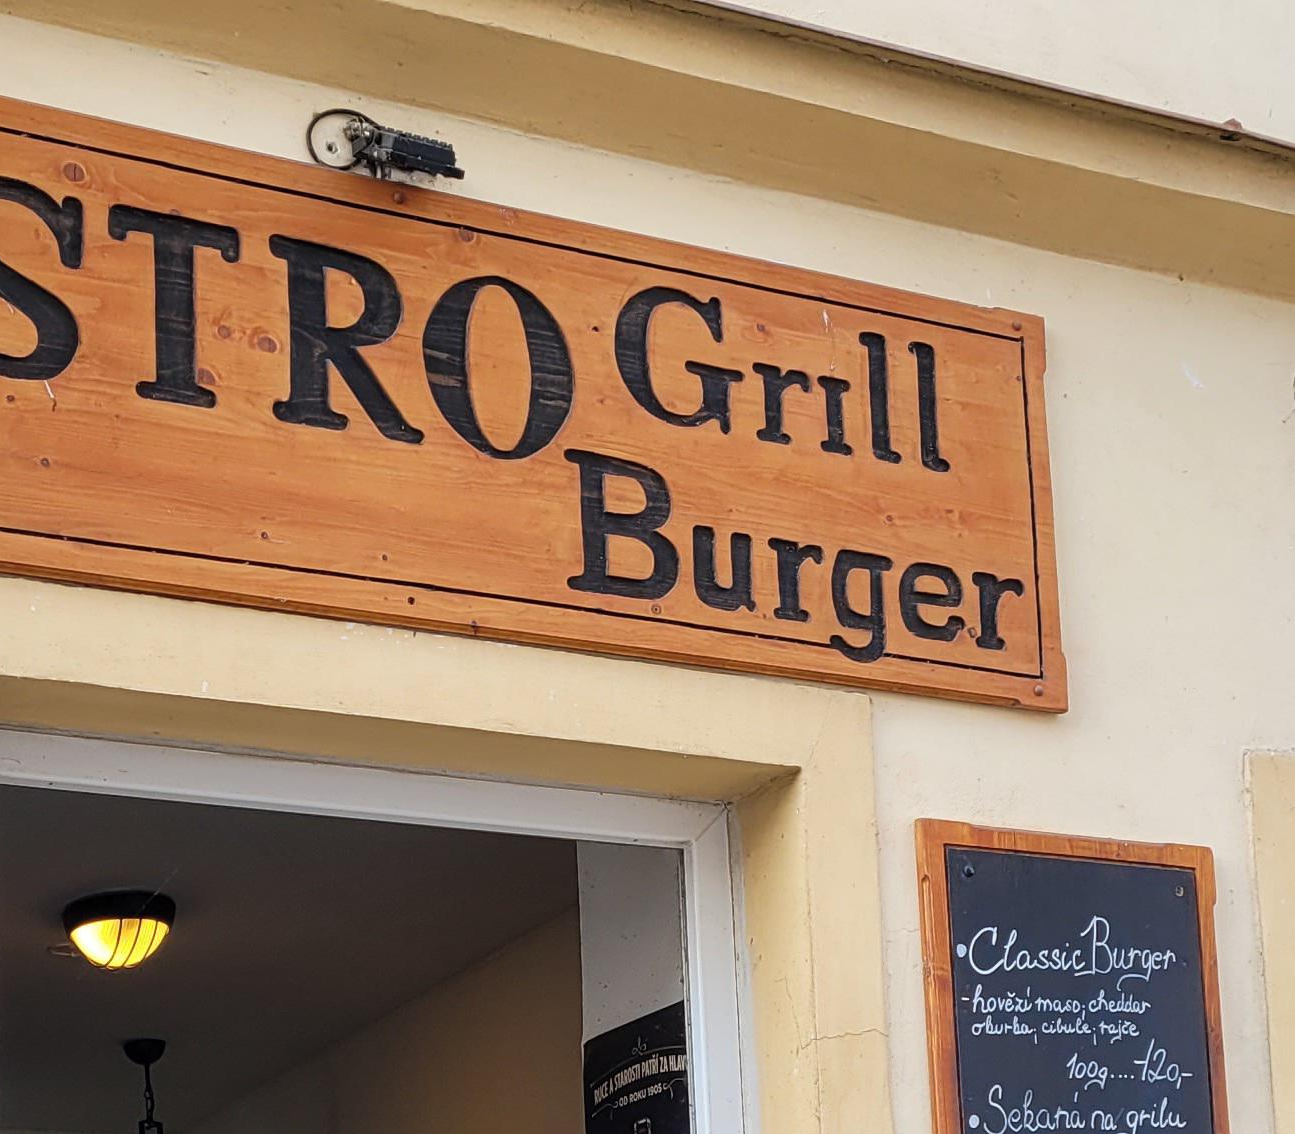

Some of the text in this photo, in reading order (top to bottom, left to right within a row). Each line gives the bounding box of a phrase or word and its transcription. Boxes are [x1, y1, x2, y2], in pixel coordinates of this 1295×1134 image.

[614, 286, 950, 473] Grill
[563, 448, 1025, 662] Burger
[969, 916, 1176, 991] Classic Burger
[1088, 989, 1151, 1015] cheddar
[1099, 1020, 1140, 1044] rajče
[659, 1055, 669, 1073] ZA
[618, 1083, 663, 1107] OD ROKU 1905
[1090, 1112, 1118, 1131] na
